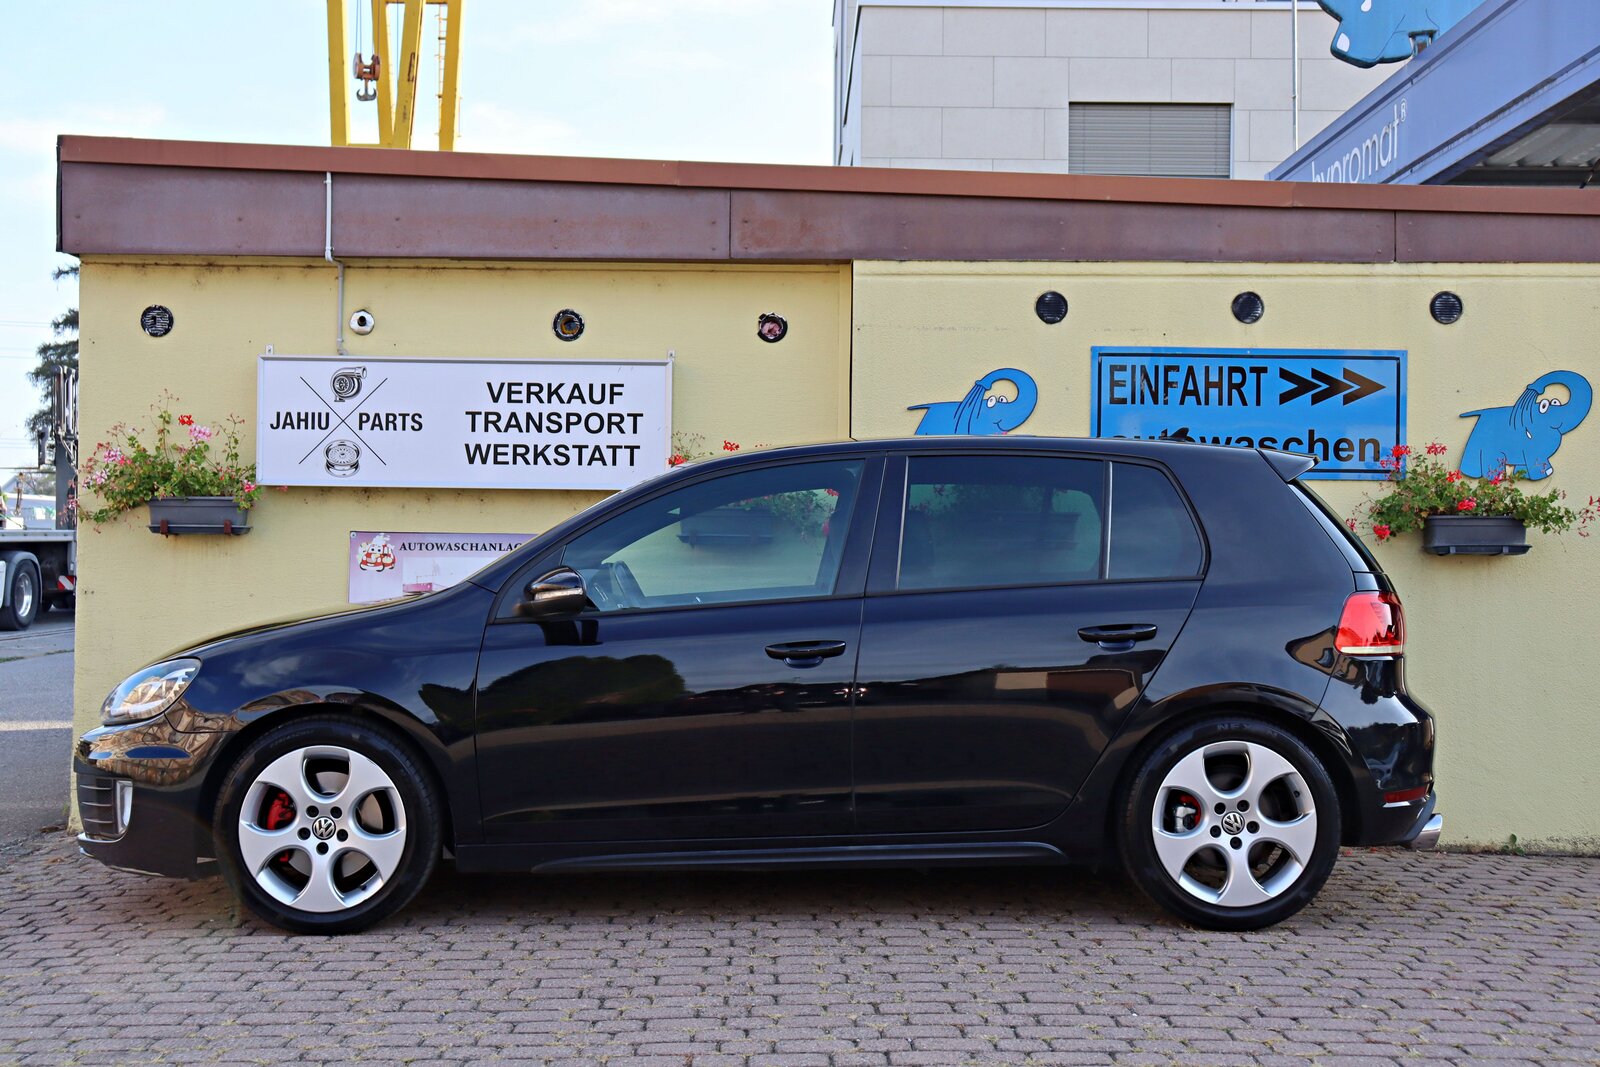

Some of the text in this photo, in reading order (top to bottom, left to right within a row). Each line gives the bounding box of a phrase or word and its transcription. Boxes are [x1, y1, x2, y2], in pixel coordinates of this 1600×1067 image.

[486, 381, 625, 405] VERKAUF
[1109, 364, 1269, 407] EINFAHRT
[269, 411, 423, 432] JAHIU PARTS
[465, 411, 644, 435] TRANSPORT
[464, 443, 641, 467] WERKSTATT
